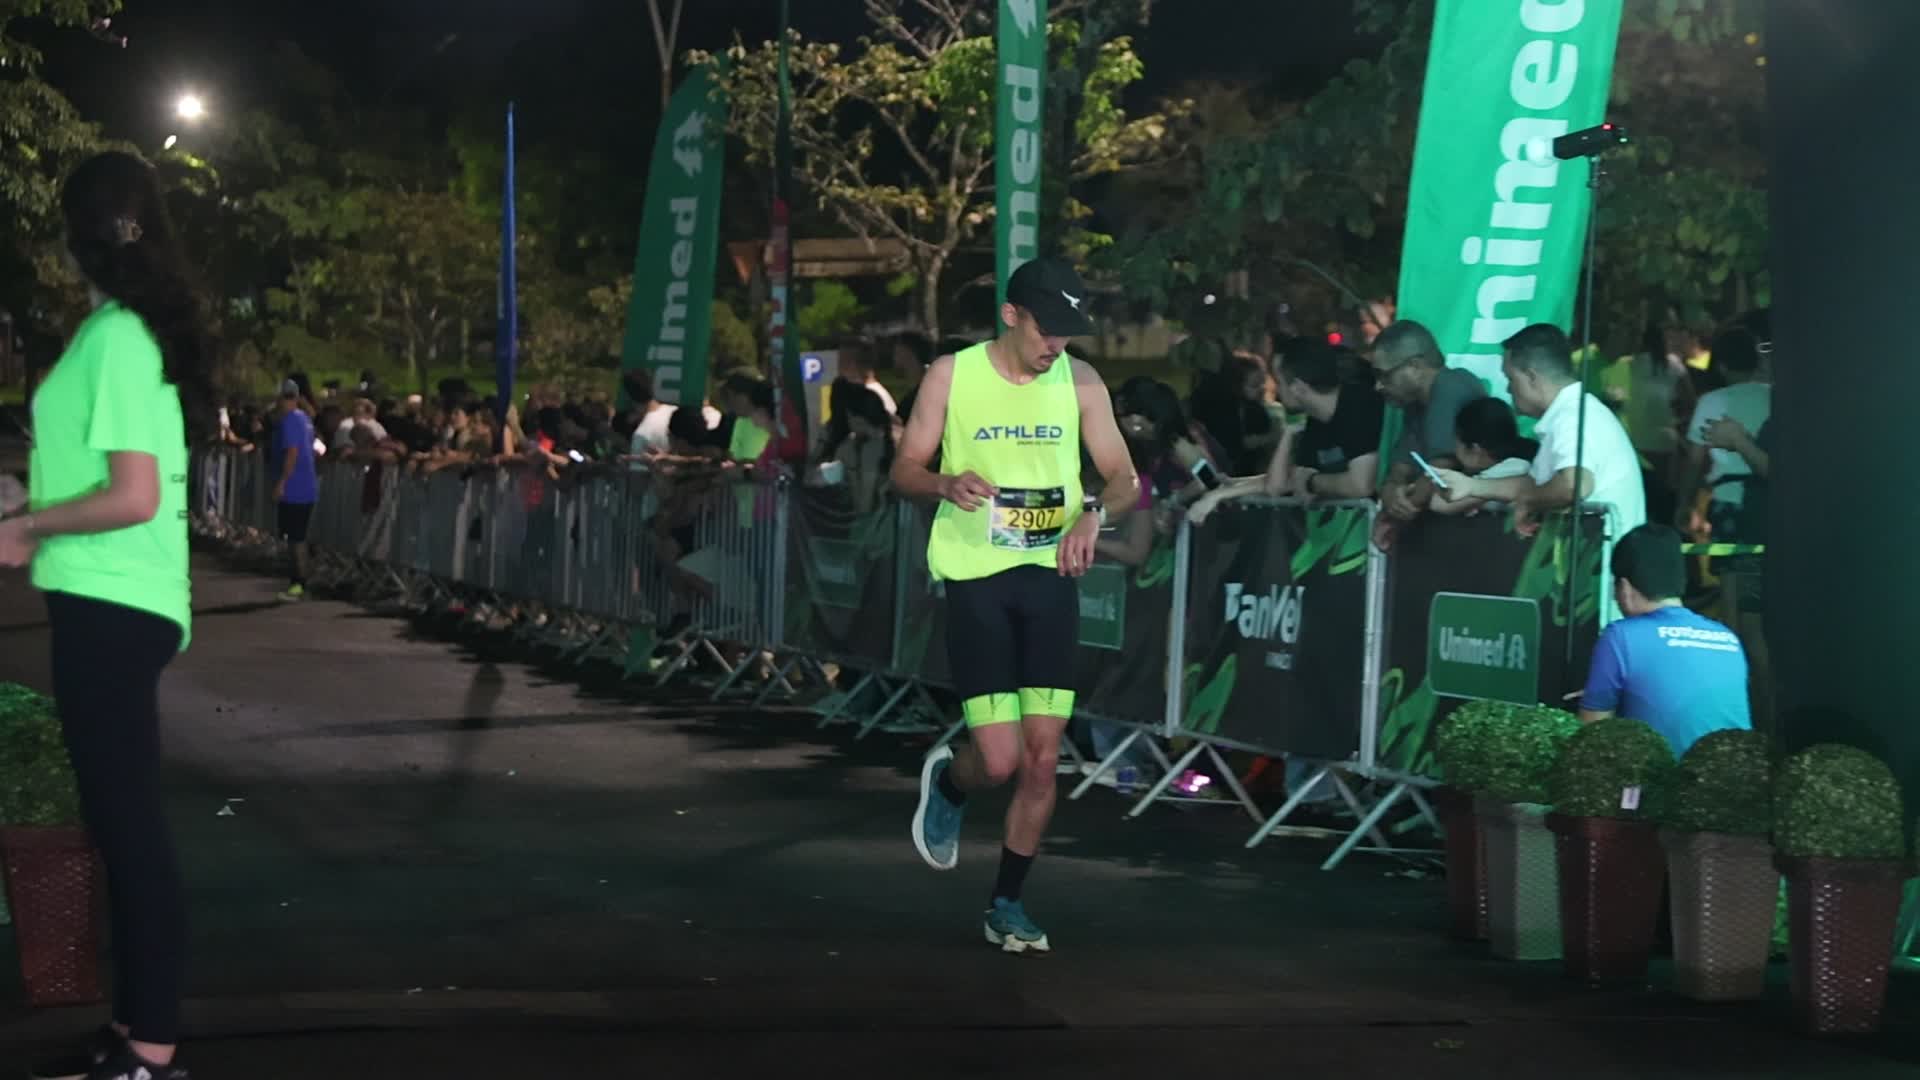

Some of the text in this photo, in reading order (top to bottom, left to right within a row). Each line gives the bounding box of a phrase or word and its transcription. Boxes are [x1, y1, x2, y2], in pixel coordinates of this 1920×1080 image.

[974, 425, 1063, 440] ATHLED
[1008, 509, 1056, 529] 2907
[1440, 626, 1505, 667] Unimed
